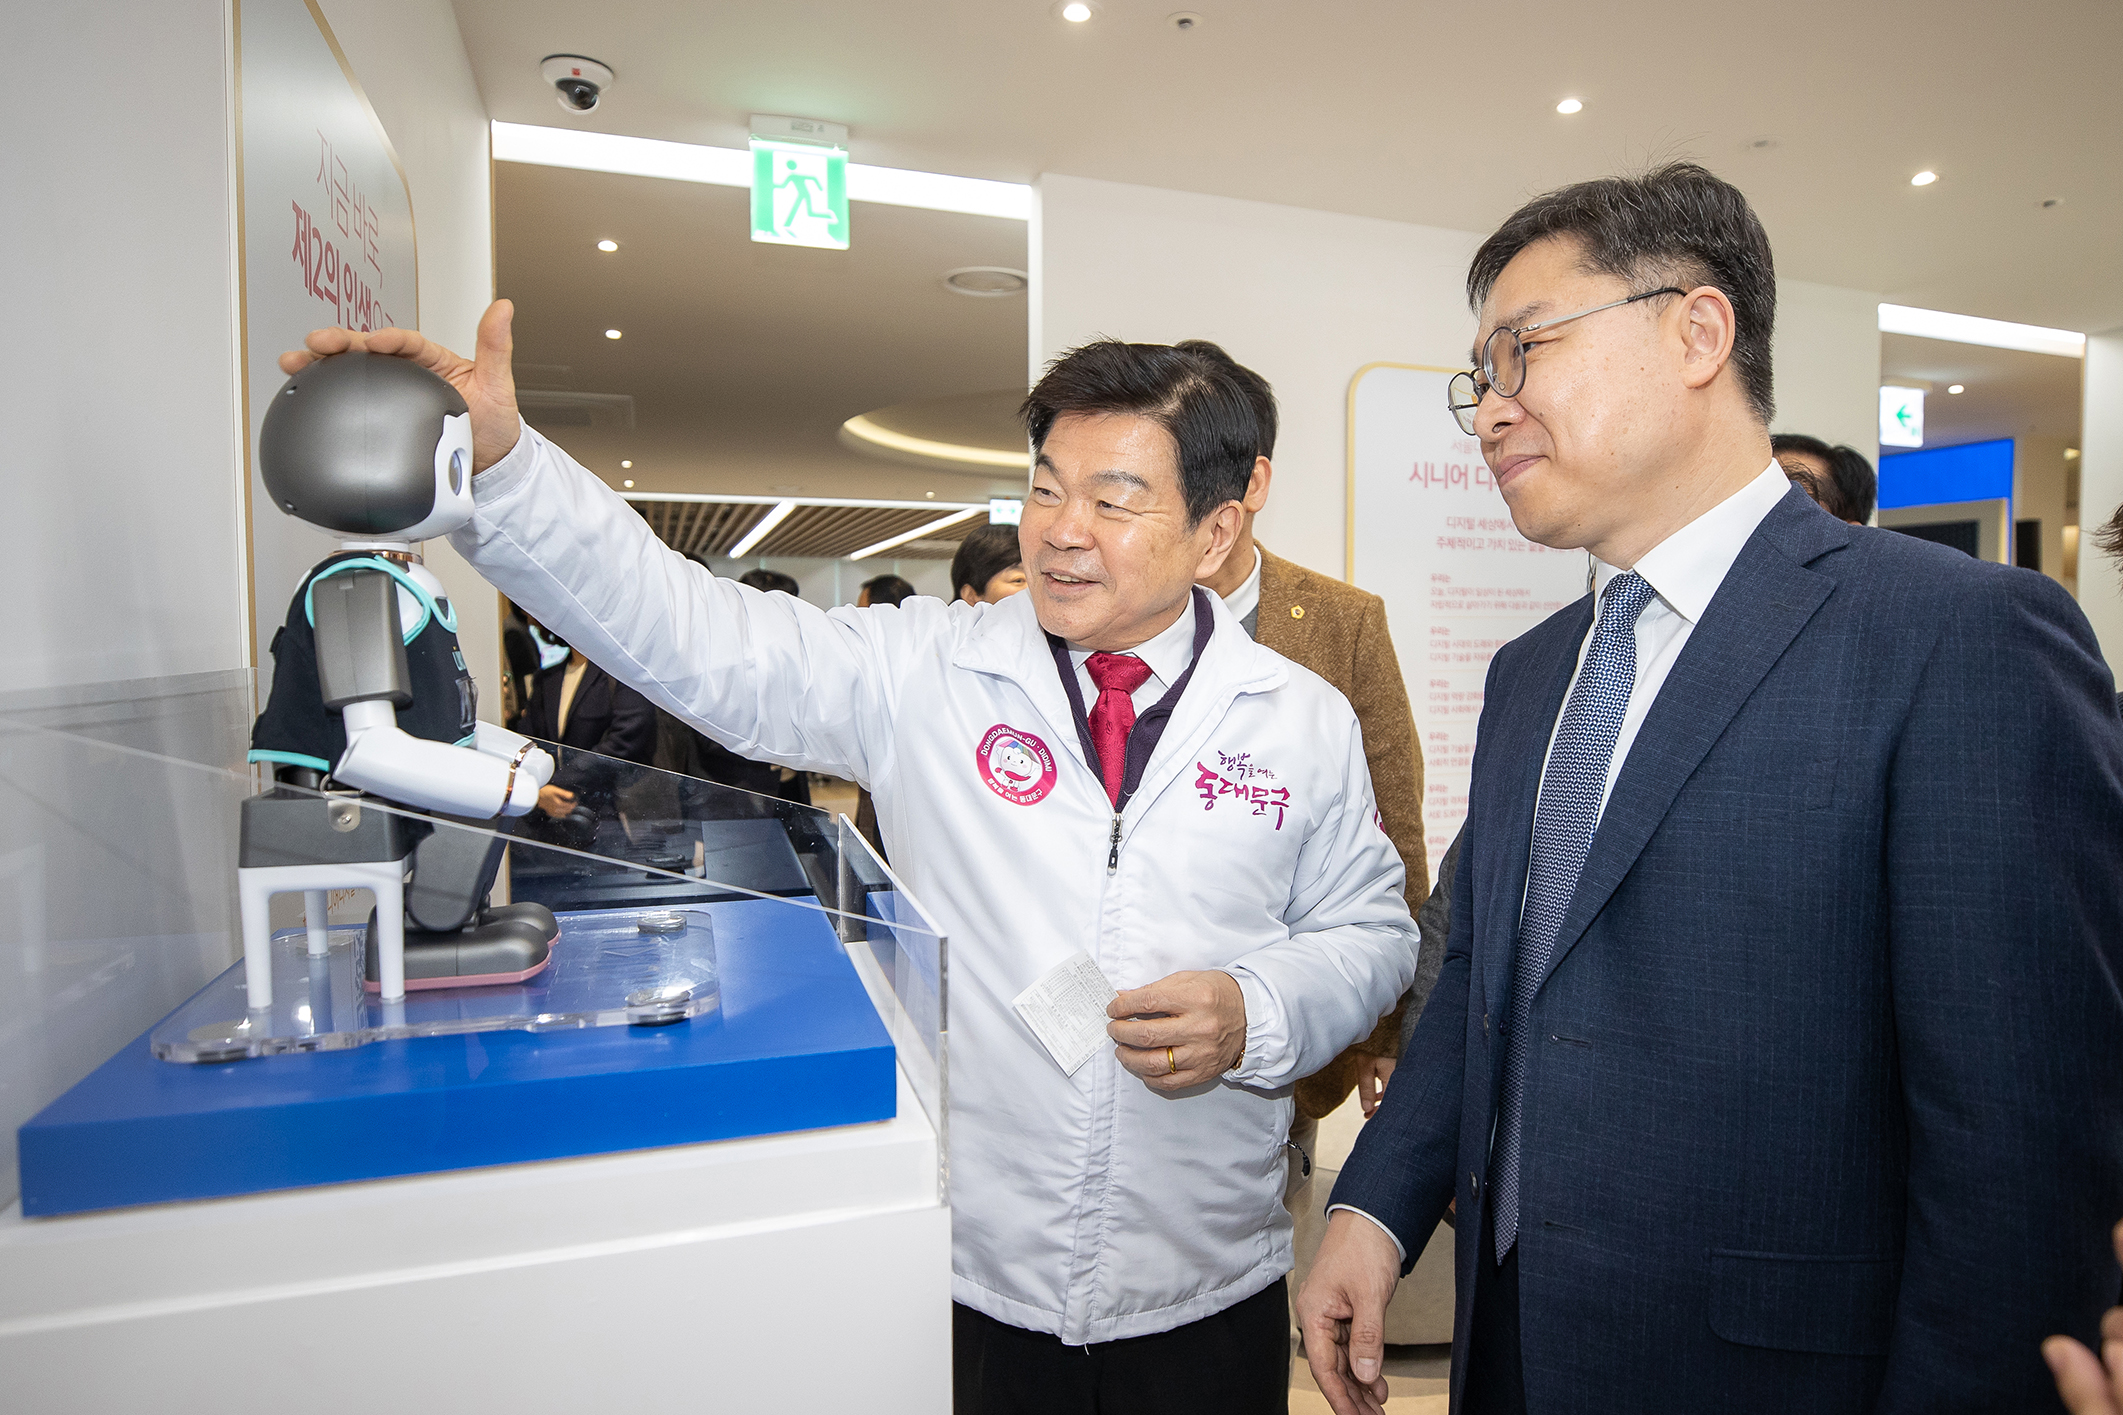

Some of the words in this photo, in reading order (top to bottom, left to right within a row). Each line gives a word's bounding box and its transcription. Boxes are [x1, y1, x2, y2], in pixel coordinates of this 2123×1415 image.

[316, 127, 351, 239] 지금
[291, 198, 341, 325] 제2의
[1409, 461, 1469, 491] 시니어
[1475, 466, 1499, 492] 디
[1446, 517, 1475, 530] 디지털
[1437, 536, 1485, 550] 주체적이고
[1487, 538, 1505, 550] 가치
[1508, 539, 1526, 553] 있는
[1217, 750, 1255, 781] 행복을
[1257, 767, 1278, 780] 여는
[1194, 760, 1291, 832] 동대문구
